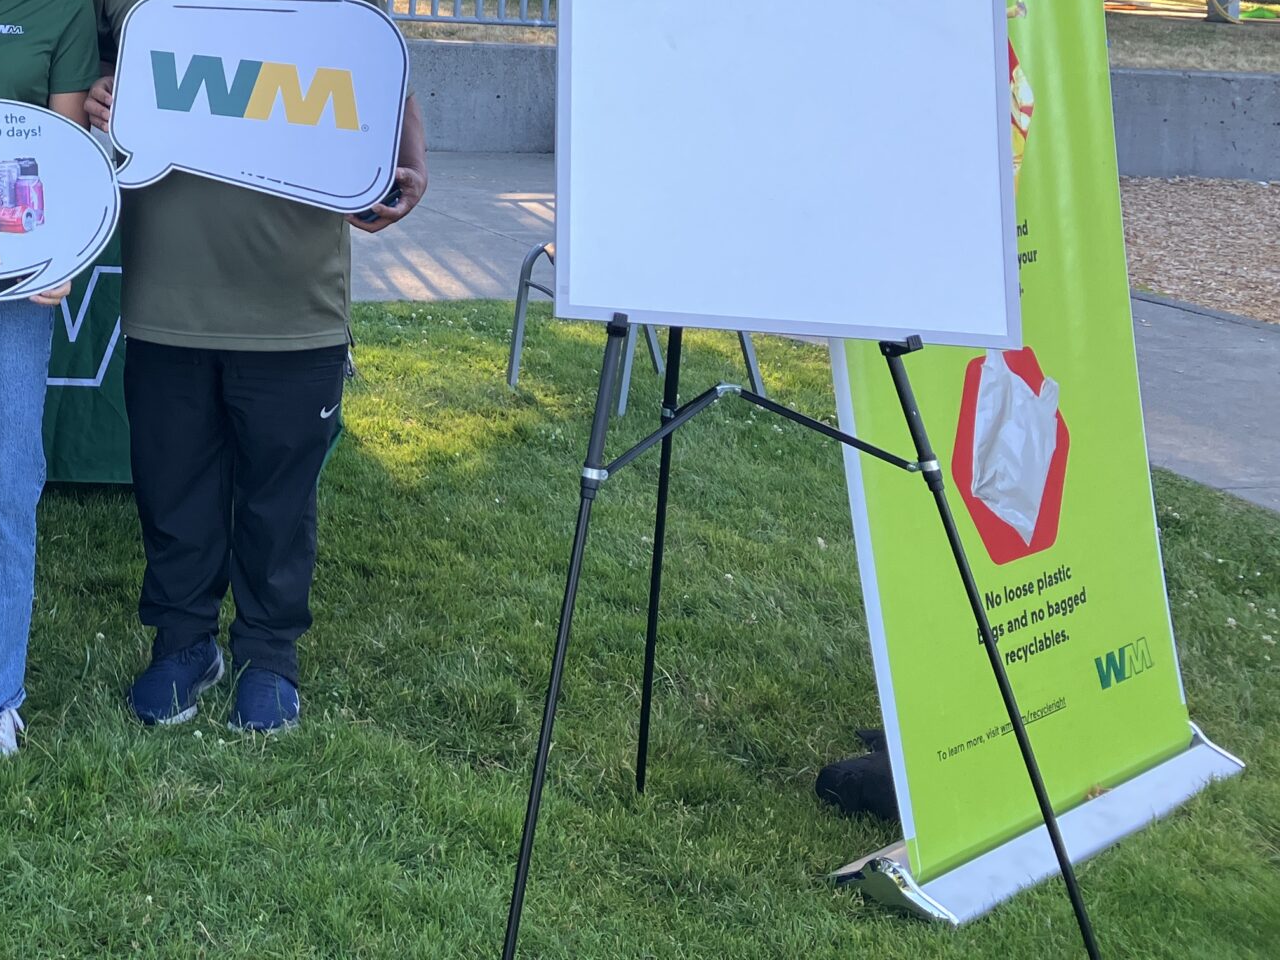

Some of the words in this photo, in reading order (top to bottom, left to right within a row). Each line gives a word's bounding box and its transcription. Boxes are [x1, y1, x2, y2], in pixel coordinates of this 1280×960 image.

[150, 50, 360, 131] WM
[4, 113, 26, 125] the
[6, 126, 42, 140] days!
[1017, 219, 1029, 237] nd
[1018, 249, 1037, 270] your
[985, 590, 1002, 610] No
[1004, 581, 1035, 603] loose
[1037, 564, 1073, 595] plastic
[1007, 610, 1028, 634] and
[1031, 608, 1045, 625] no
[1046, 586, 1087, 617] bagged
[1005, 627, 1070, 665] recyclables.
[1095, 636, 1153, 690] WM
[937, 750, 947, 761] To
[948, 743, 965, 757] learn
[967, 736, 985, 750] more,
[986, 726, 1000, 740] visit
